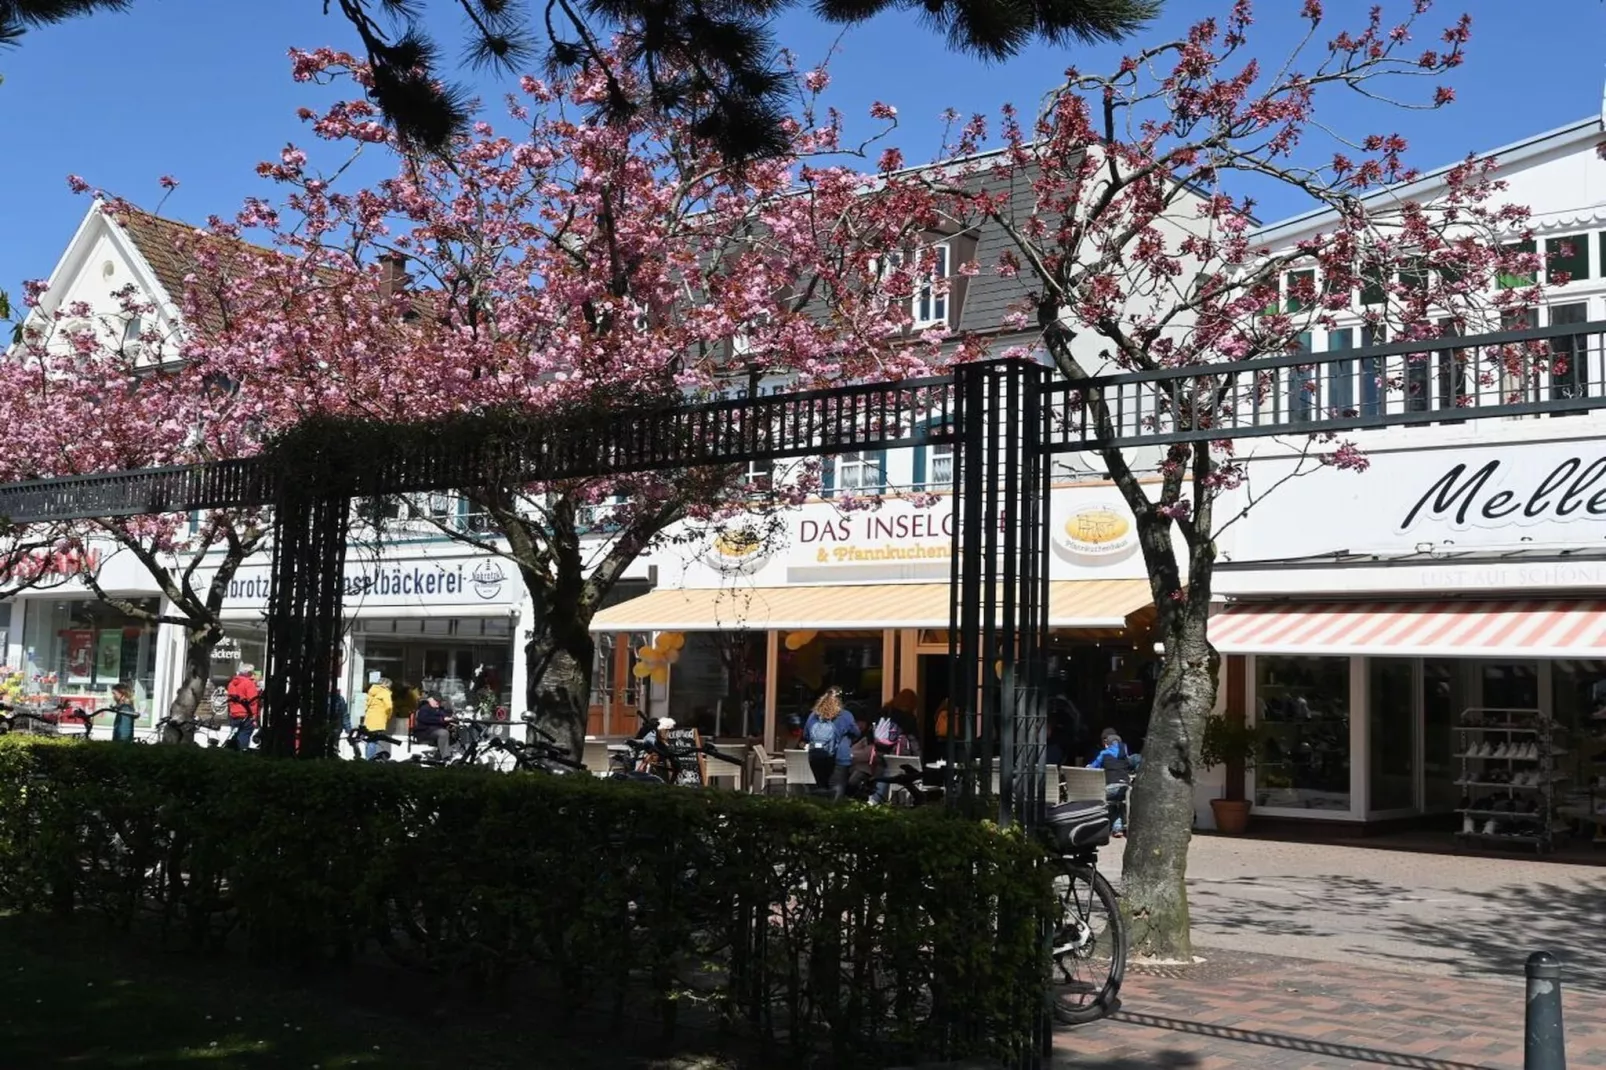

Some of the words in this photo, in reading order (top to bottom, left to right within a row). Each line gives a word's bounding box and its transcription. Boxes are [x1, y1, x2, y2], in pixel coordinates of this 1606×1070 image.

[800, 516, 851, 543] DAS
[816, 547, 829, 563] &
[342, 564, 463, 597] nselbäckerei
